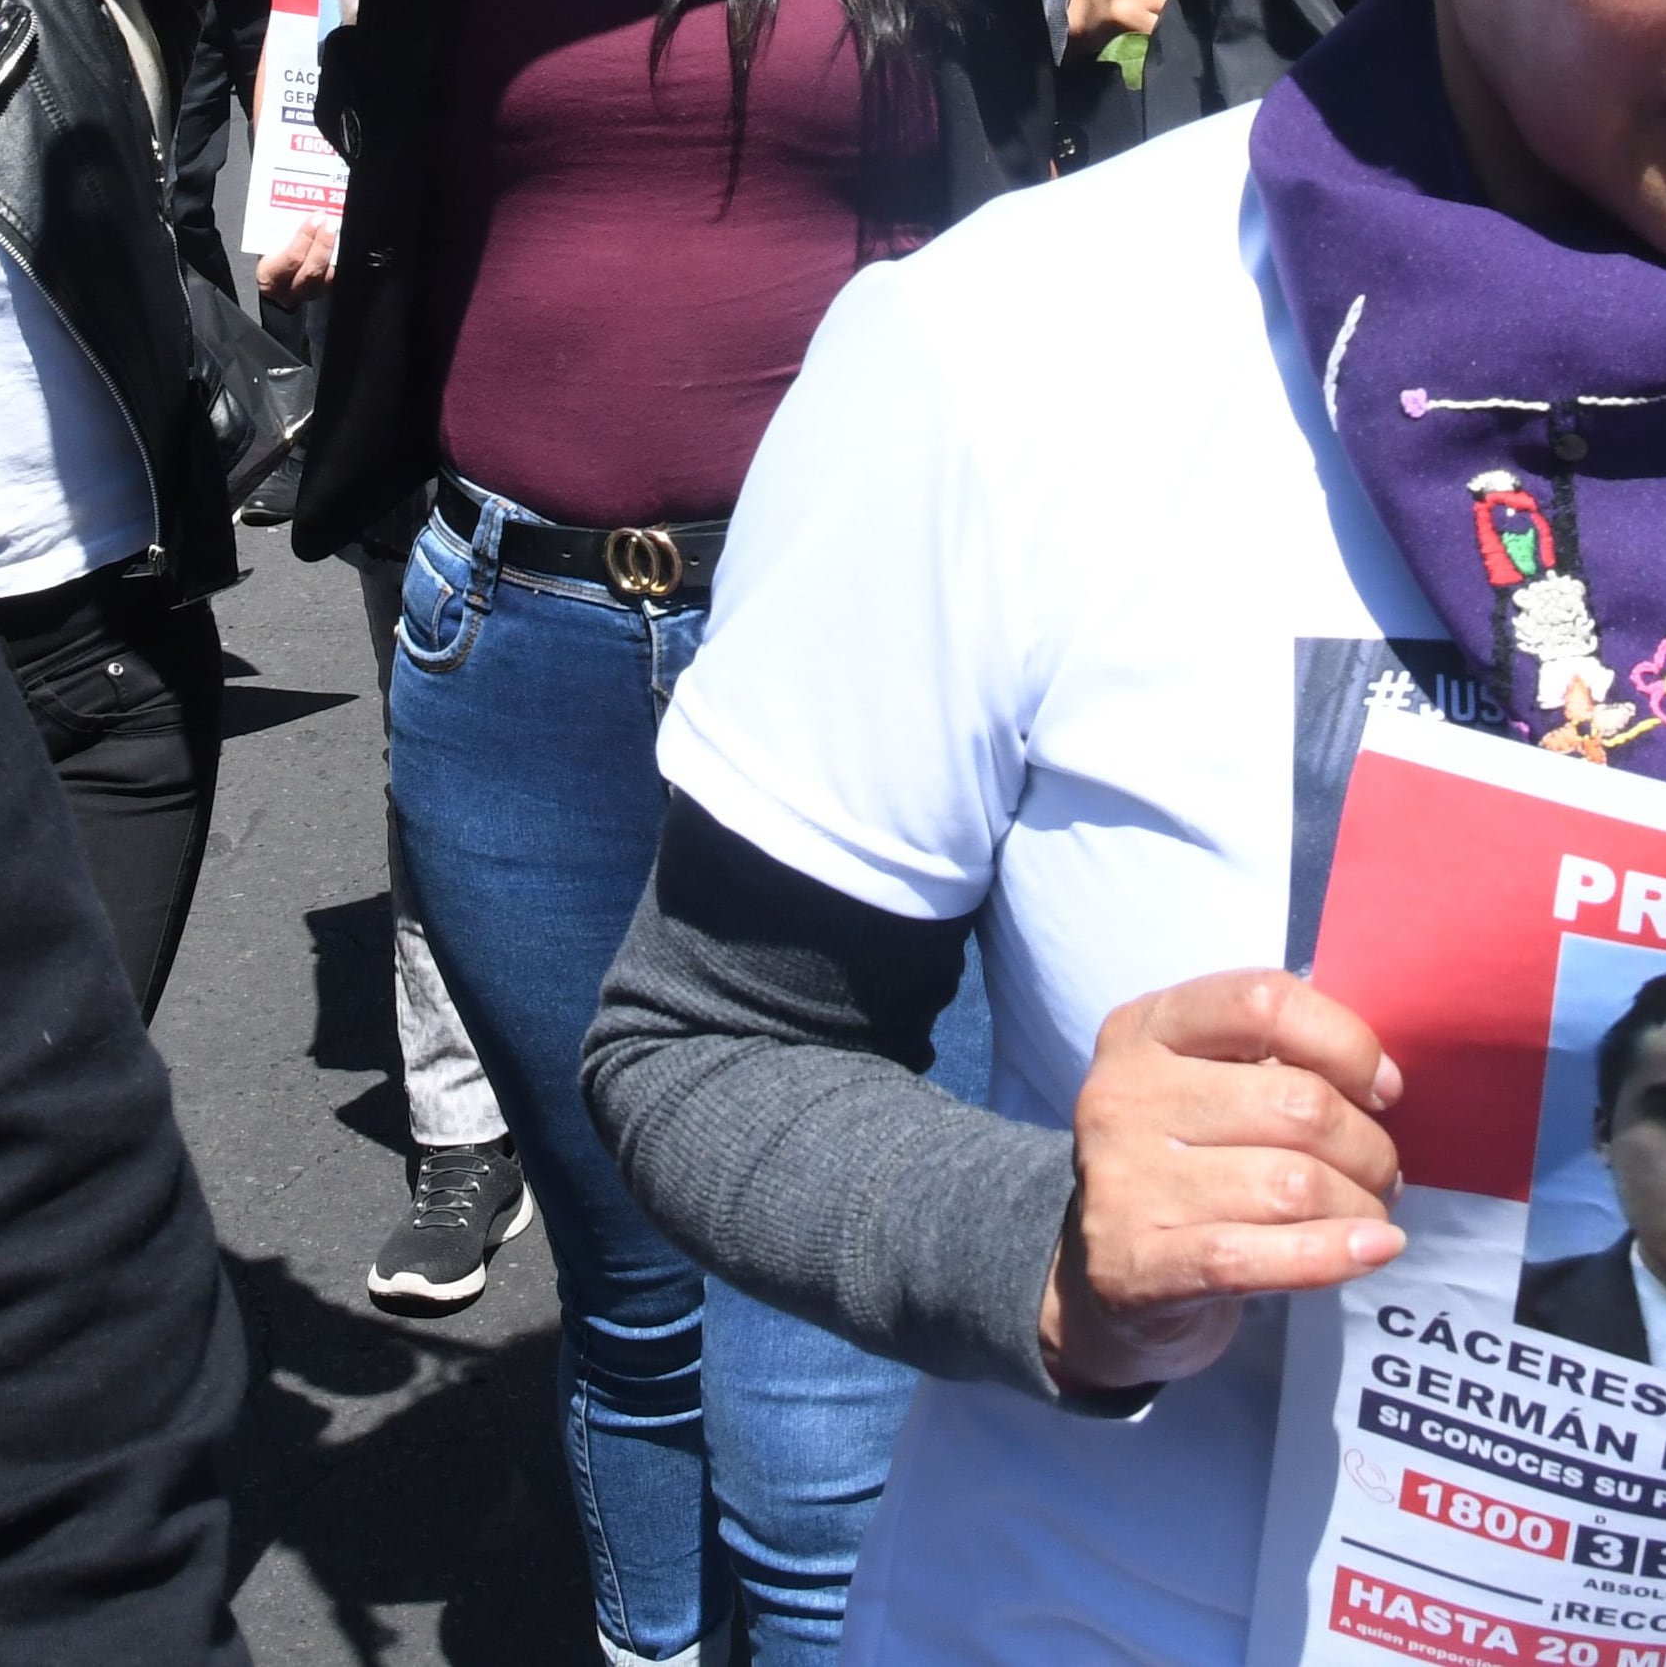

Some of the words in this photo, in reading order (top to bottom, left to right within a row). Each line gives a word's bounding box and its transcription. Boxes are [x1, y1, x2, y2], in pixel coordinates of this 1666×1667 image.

[275, 182, 326, 202] HASTA
[1370, 1353, 1638, 1464] GERMÁN
[1377, 1404, 1412, 1432] SI
[1420, 1418, 1585, 1489] CONOCES
[1594, 1475, 1643, 1503] SU
[1416, 1482, 1555, 1553] 1800
[1347, 1578, 1519, 1656] HASTA
[1534, 1635, 1600, 1667] 20
